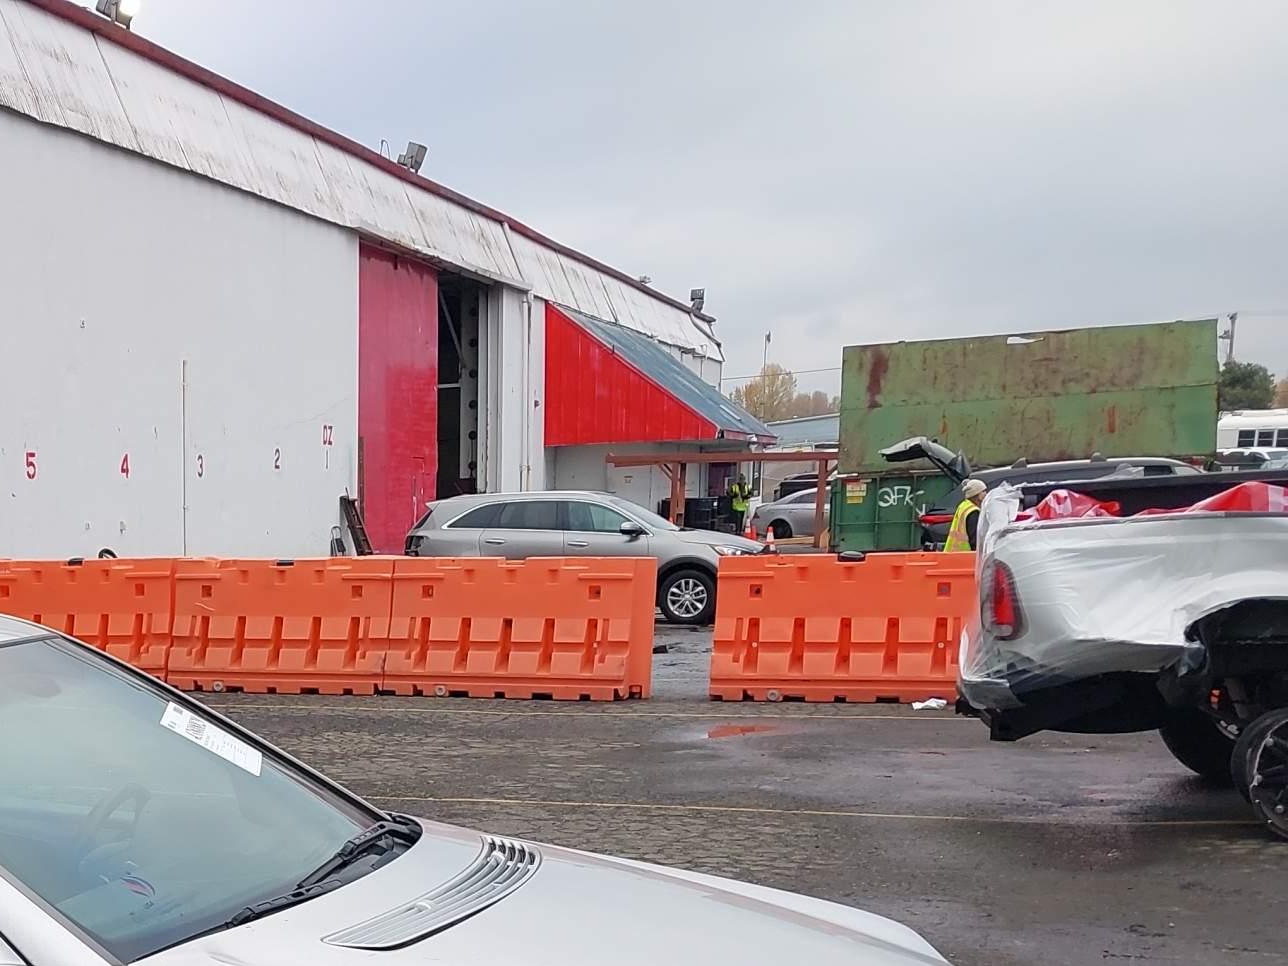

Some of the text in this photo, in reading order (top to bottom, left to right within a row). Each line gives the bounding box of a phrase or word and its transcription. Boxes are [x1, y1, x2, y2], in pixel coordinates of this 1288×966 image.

[25, 451, 37, 480] 5
[120, 453, 130, 479] 4
[197, 454, 204, 478] 3
[274, 448, 281, 470] 2
